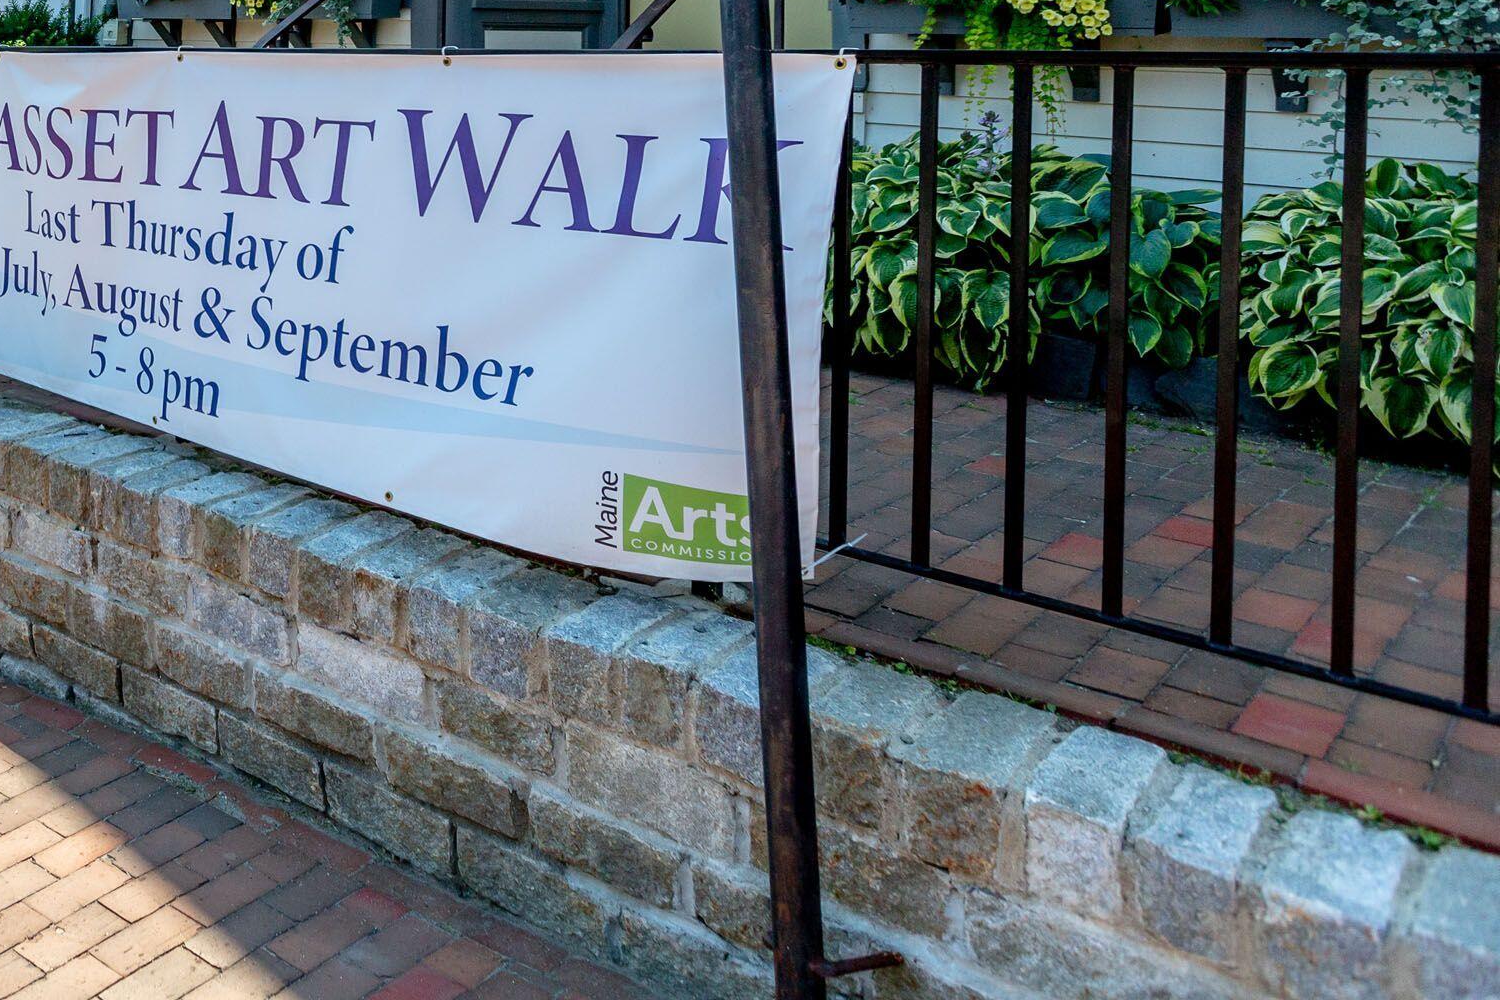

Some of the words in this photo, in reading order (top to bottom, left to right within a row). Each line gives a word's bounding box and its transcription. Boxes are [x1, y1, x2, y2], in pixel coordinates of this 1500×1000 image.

[179, 99, 376, 207] ART
[24, 190, 81, 244] Last
[91, 199, 288, 293] Thursday
[296, 225, 355, 284] of
[0, 246, 57, 316] July,
[62, 263, 184, 337] August
[193, 286, 236, 344] &
[246, 295, 535, 407] September
[594, 470, 619, 549] Maine
[631, 538, 752, 562] COMMISSIO
